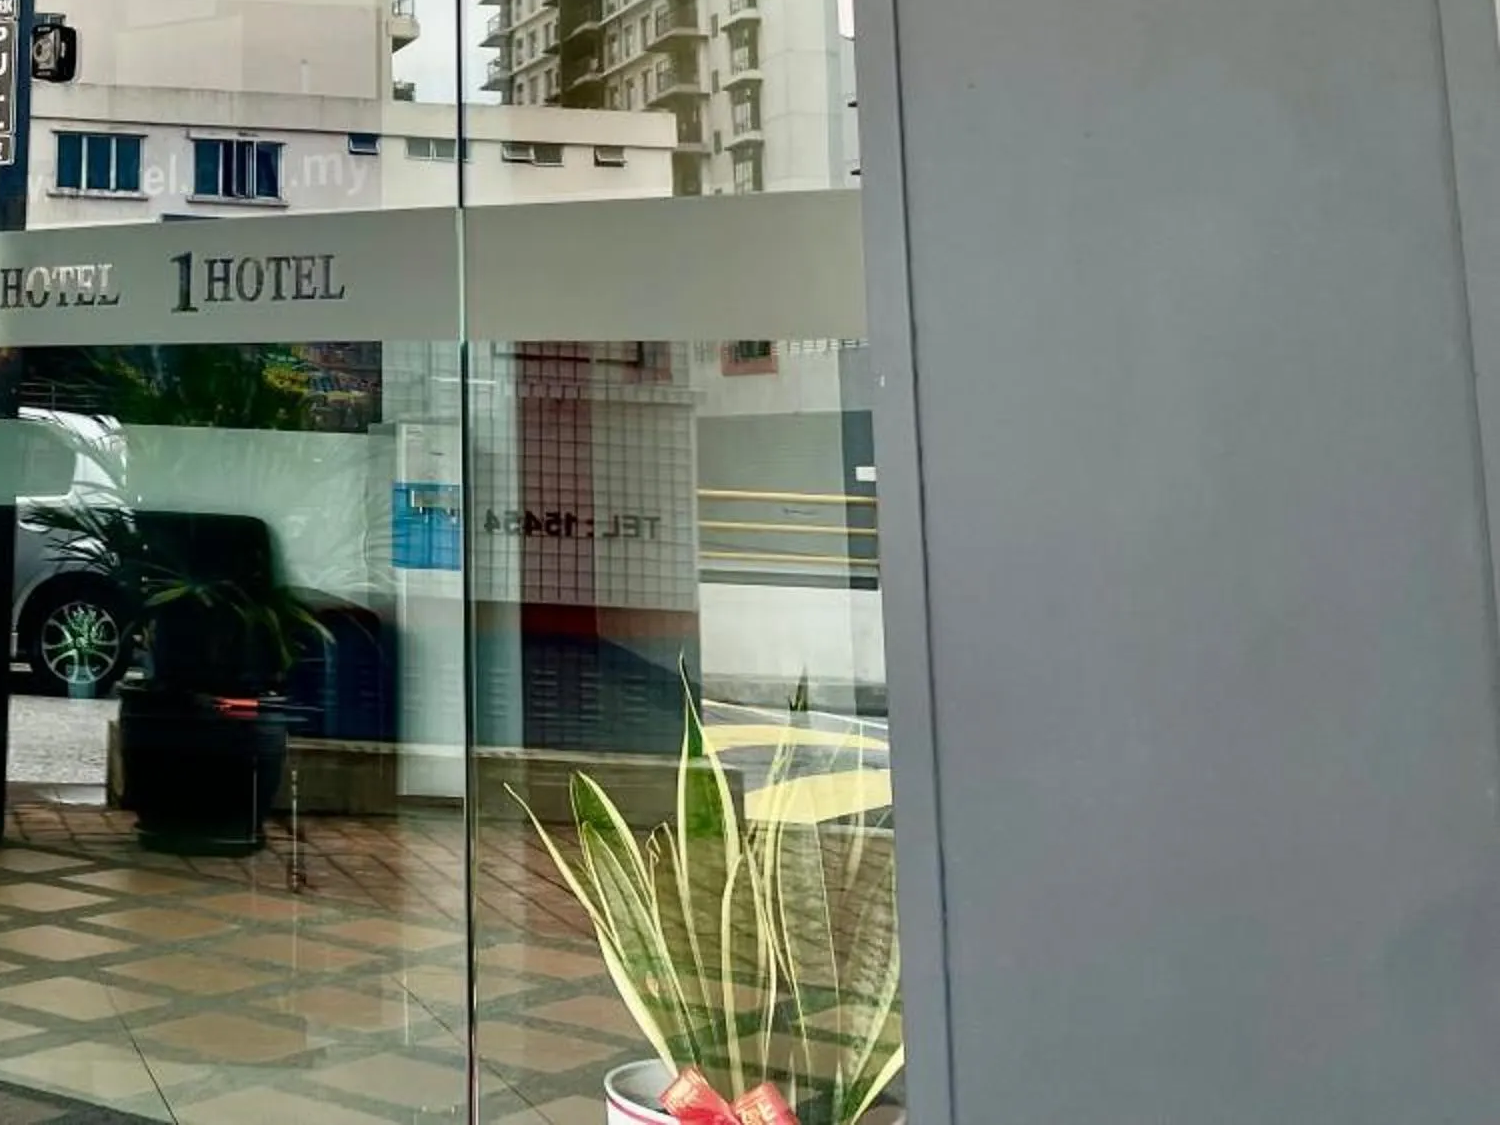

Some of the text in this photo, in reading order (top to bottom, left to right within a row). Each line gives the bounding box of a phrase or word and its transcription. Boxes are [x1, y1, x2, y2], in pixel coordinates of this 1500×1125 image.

[0, 263, 120, 309] HOTEL
[170, 251, 345, 314] 1 HOTEL
